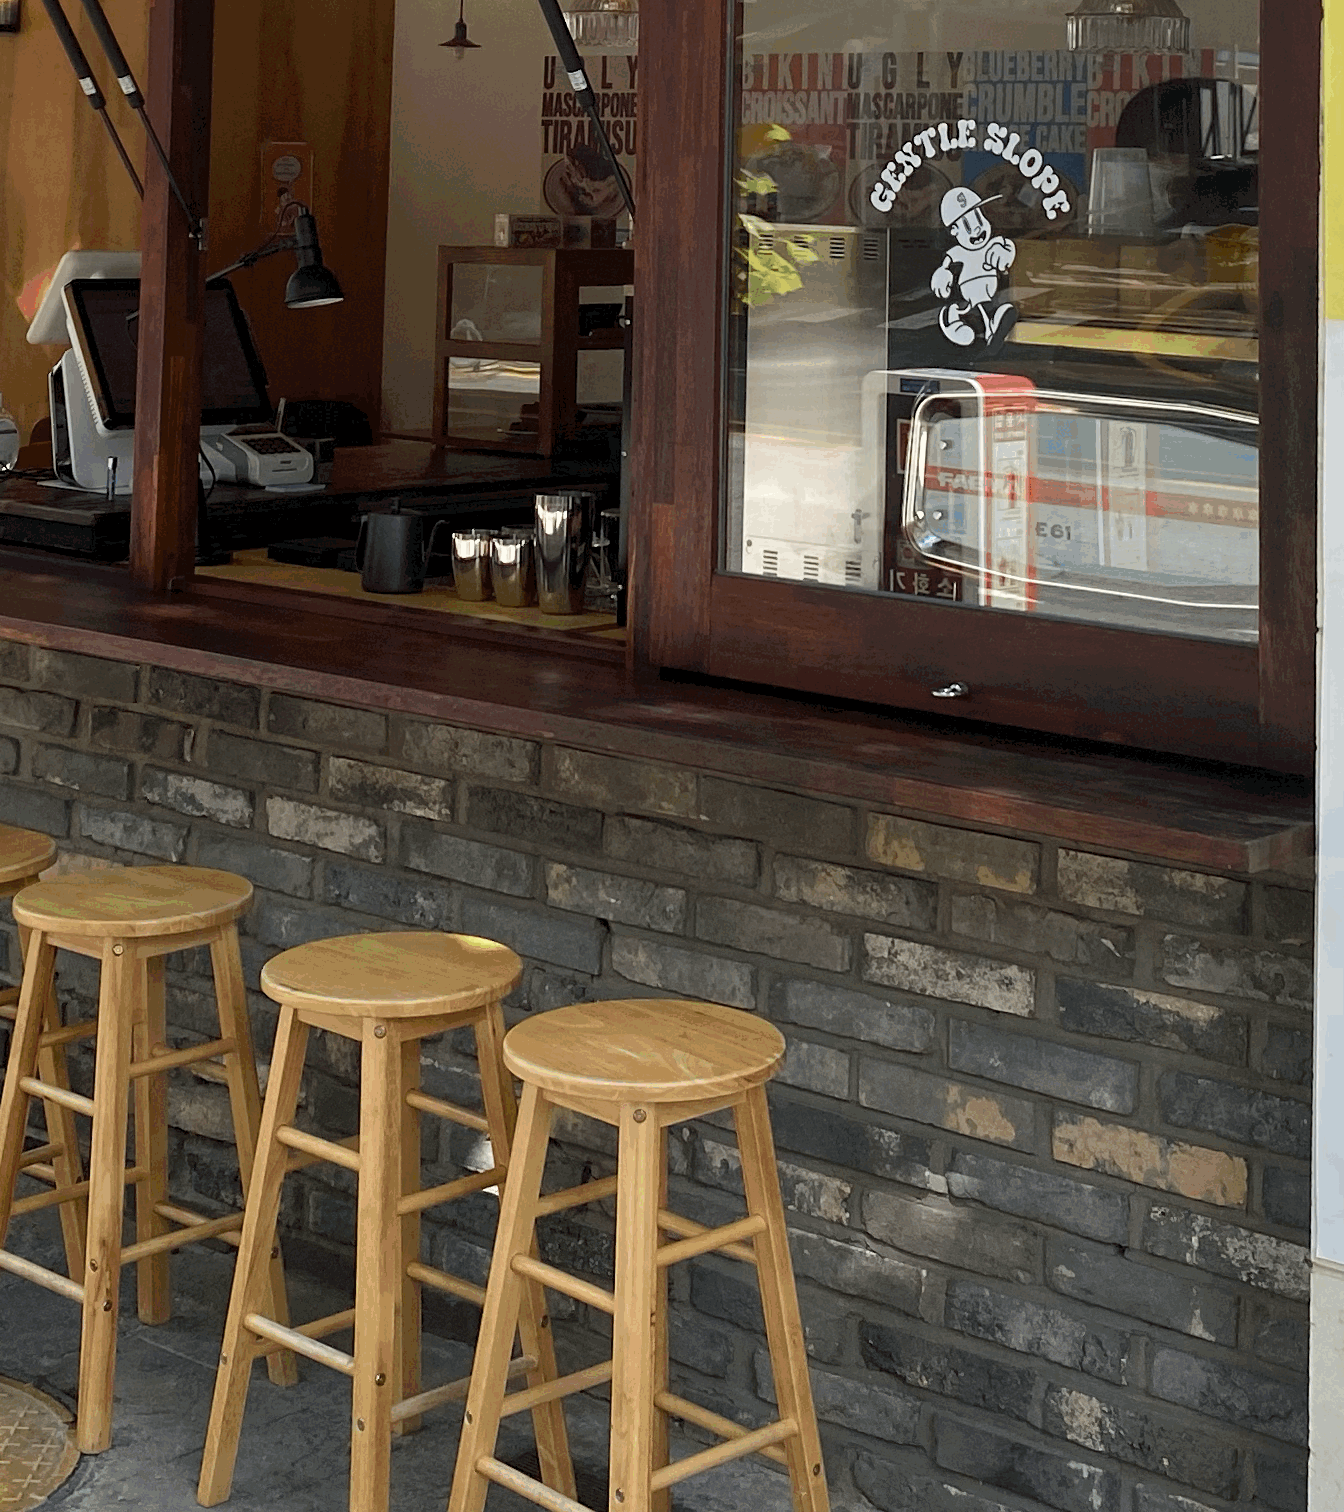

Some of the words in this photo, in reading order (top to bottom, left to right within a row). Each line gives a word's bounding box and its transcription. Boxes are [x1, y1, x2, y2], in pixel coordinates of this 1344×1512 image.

[543, 56, 637, 89] ULY
[742, 53, 848, 89] BIKINI
[848, 52, 963, 89] UGLY
[963, 51, 1086, 81] BLUEBERRY
[742, 91, 847, 124] CROISSANT
[847, 92, 963, 120] MASCARPONE
[963, 83, 1086, 122] CRUMBLE
[1036, 125, 1086, 153] CAKE
[870, 119, 976, 212] GENTLE
[984, 122, 1070, 220] SLOPE
[1035, 522, 1071, 541] E61
